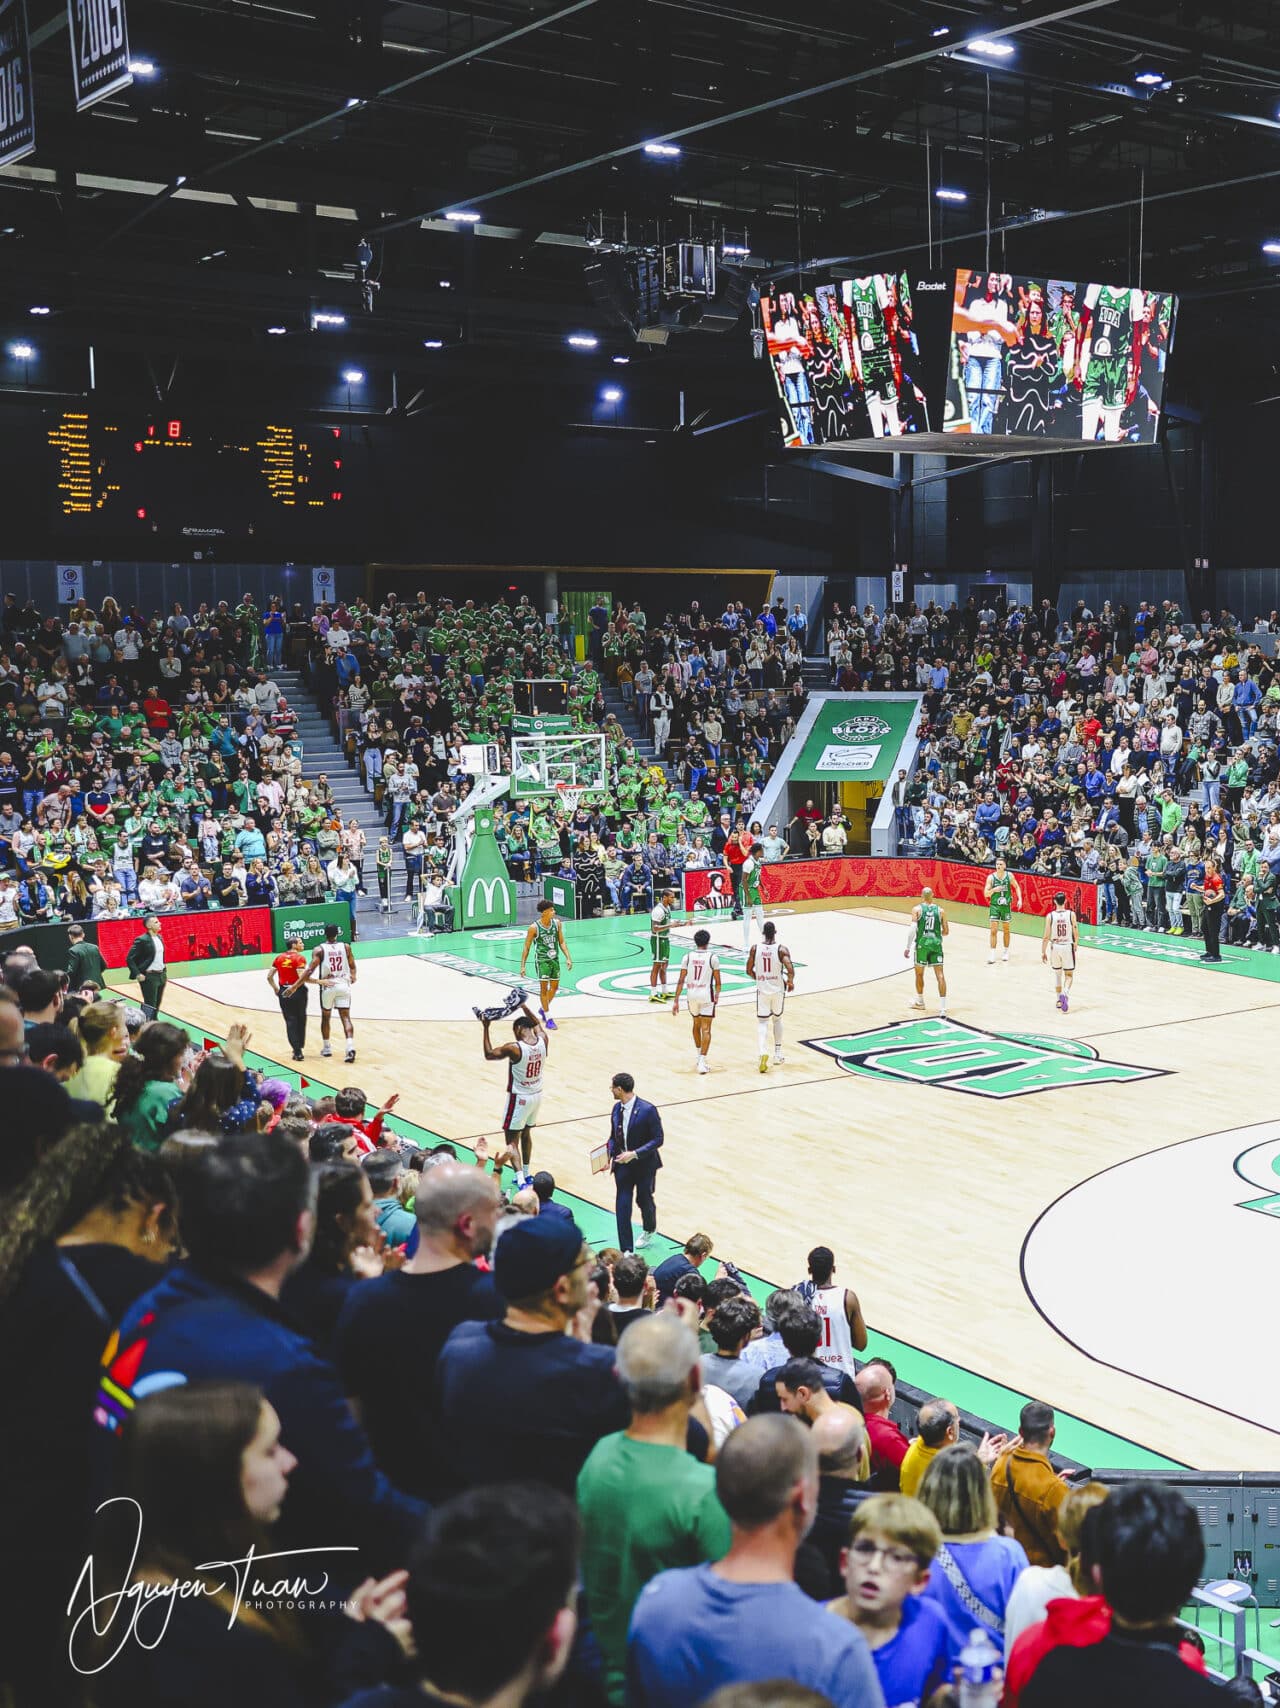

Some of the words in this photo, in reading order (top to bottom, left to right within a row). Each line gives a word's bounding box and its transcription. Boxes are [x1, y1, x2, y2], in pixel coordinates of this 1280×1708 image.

[0, 57, 24, 132] 016
[916, 281, 946, 290] Bodet
[832, 726, 891, 734] BLOIS
[329, 956, 343, 972] 32
